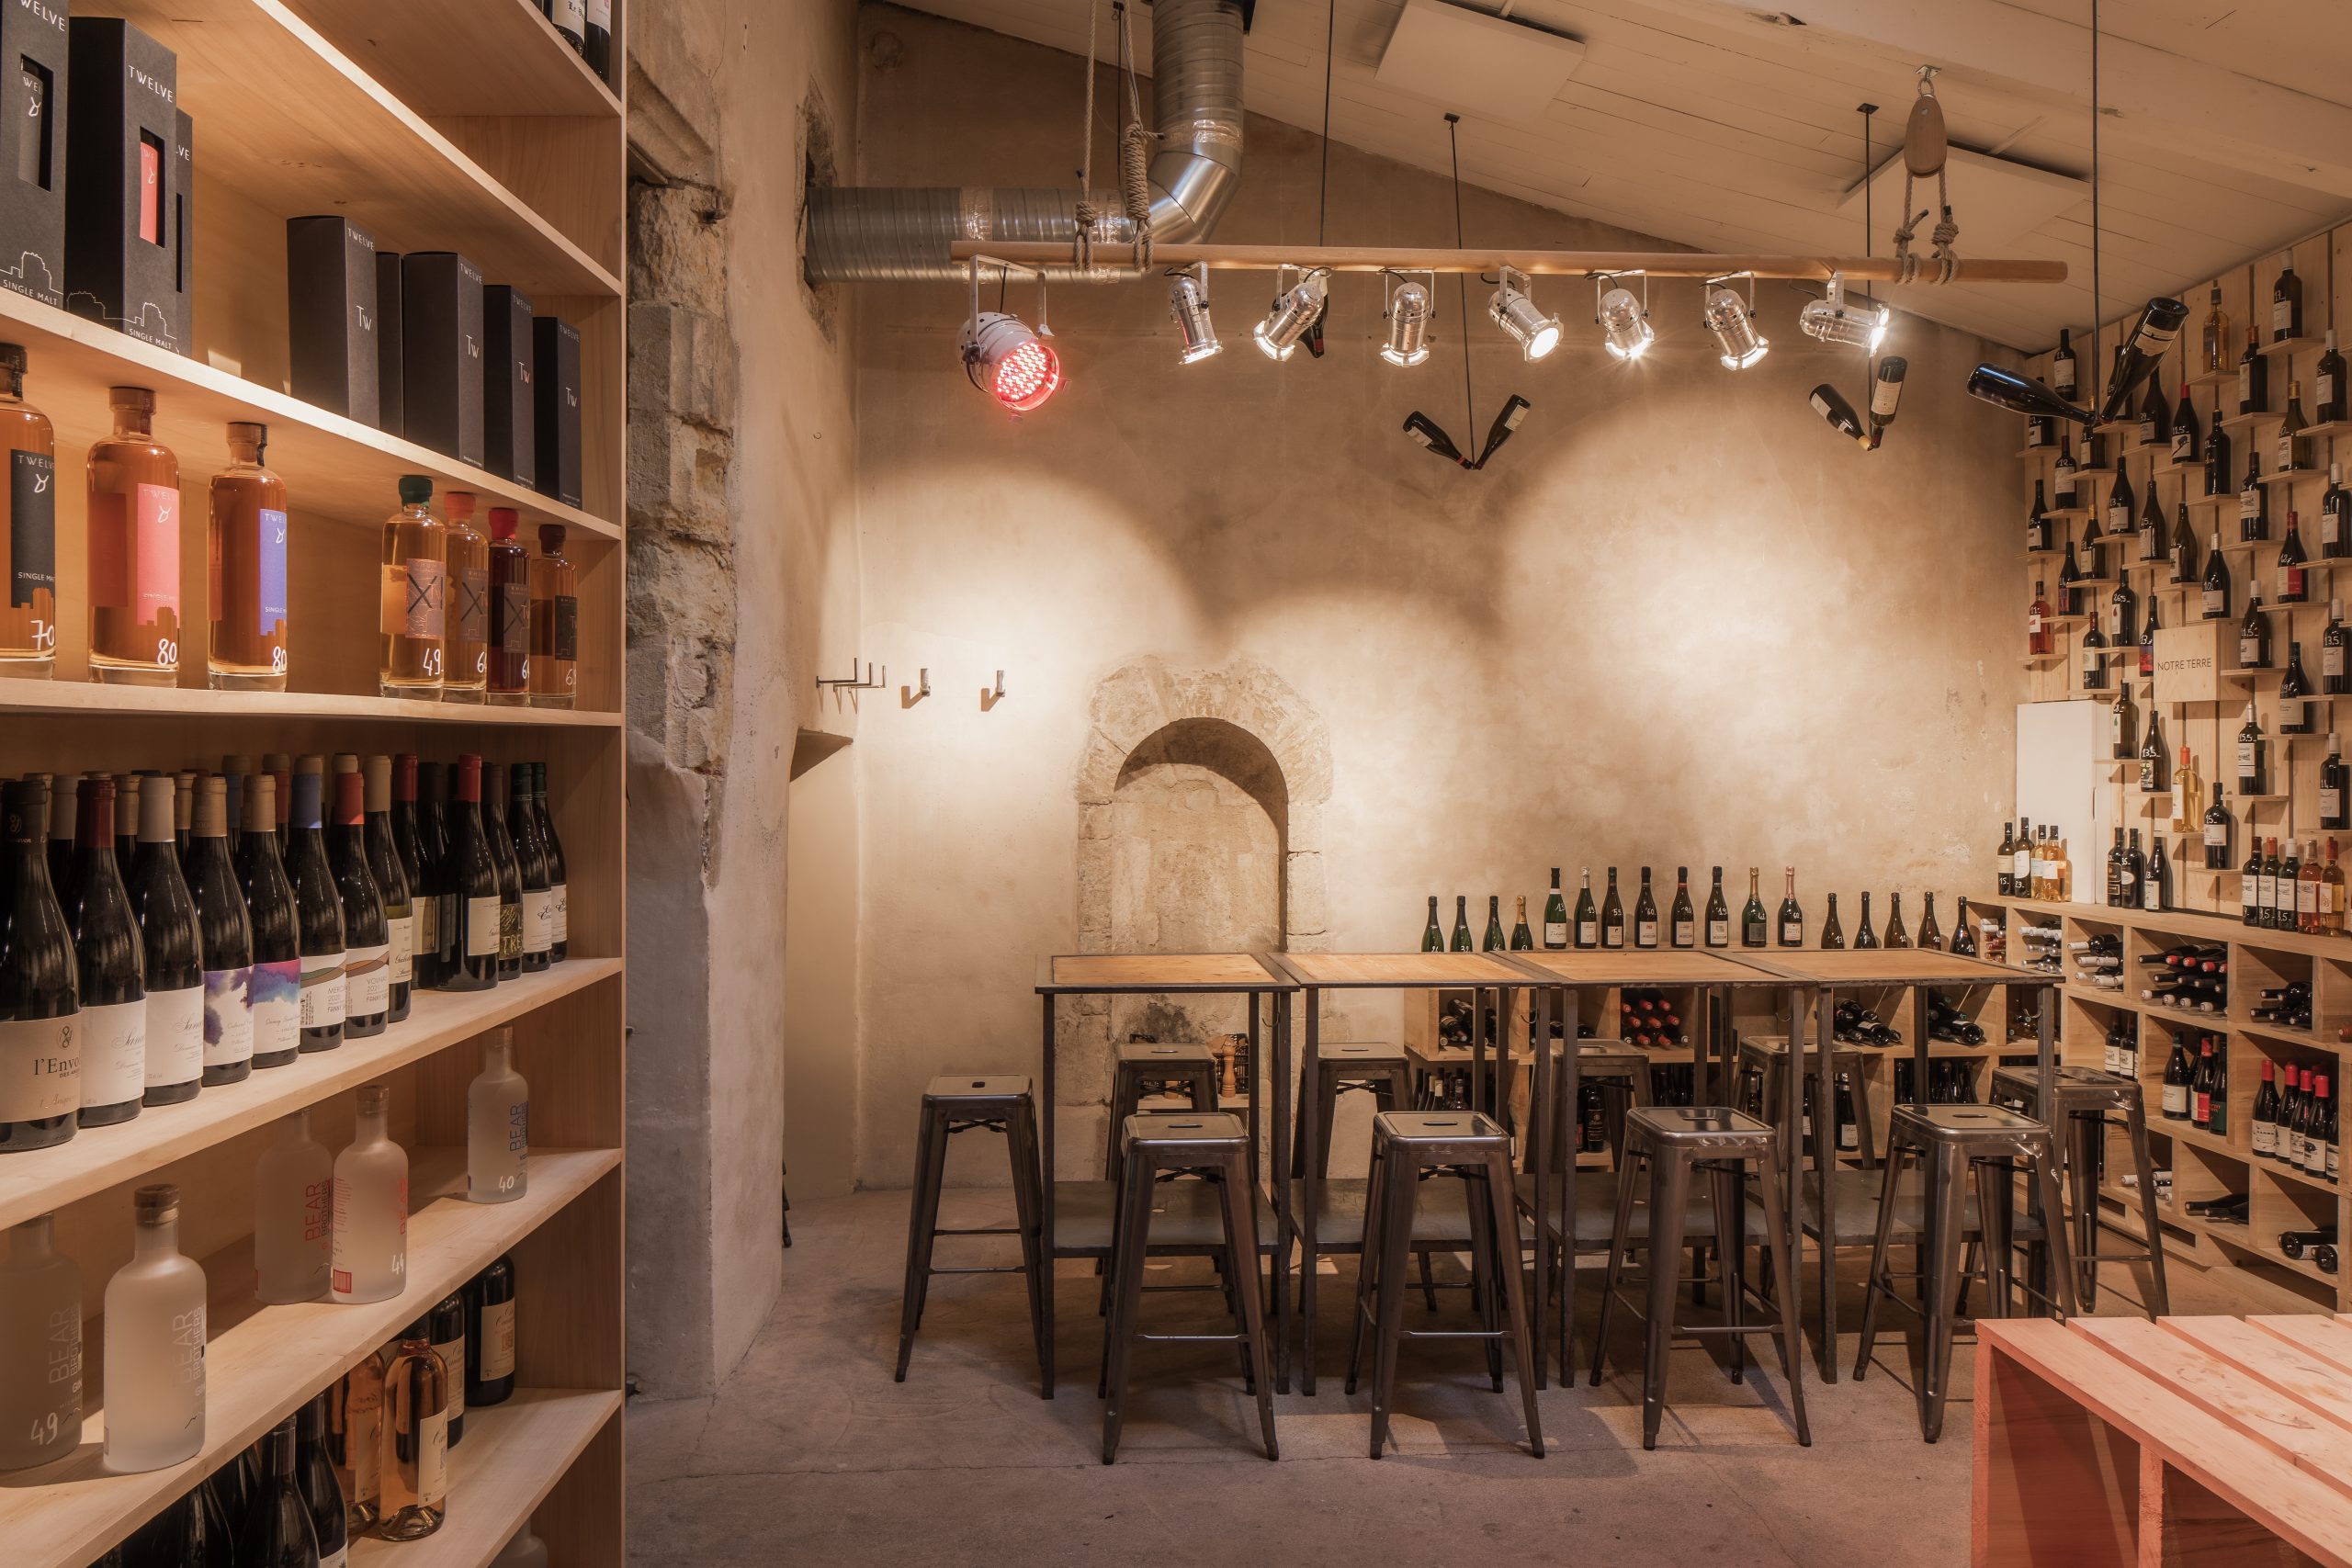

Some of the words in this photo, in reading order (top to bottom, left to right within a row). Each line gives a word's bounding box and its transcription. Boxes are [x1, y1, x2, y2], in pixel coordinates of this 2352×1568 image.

[128, 65, 174, 103] TWELVE
[347, 228, 374, 251] TWELVE
[459, 263, 482, 284] TWELVE
[3, 279, 34, 297] SINGLE
[37, 292, 57, 306] MALT
[129, 328, 153, 342] SINGLE
[155, 339, 172, 350] MALT
[17, 455, 54, 471] TWELV
[17, 571, 45, 581] SINGLE
[157, 637, 177, 666] 80
[273, 646, 287, 674] 80
[2157, 660, 2185, 671] NOTRE
[2188, 658, 2211, 669] TERRE
[510, 1105, 522, 1151] BEAR
[499, 1176, 514, 1192] 40
[305, 1182, 322, 1241] BEAR
[49, 1308, 70, 1384] BEAR
[192, 1307, 202, 1379] BROTHERS
[30, 1413, 58, 1445] 49
